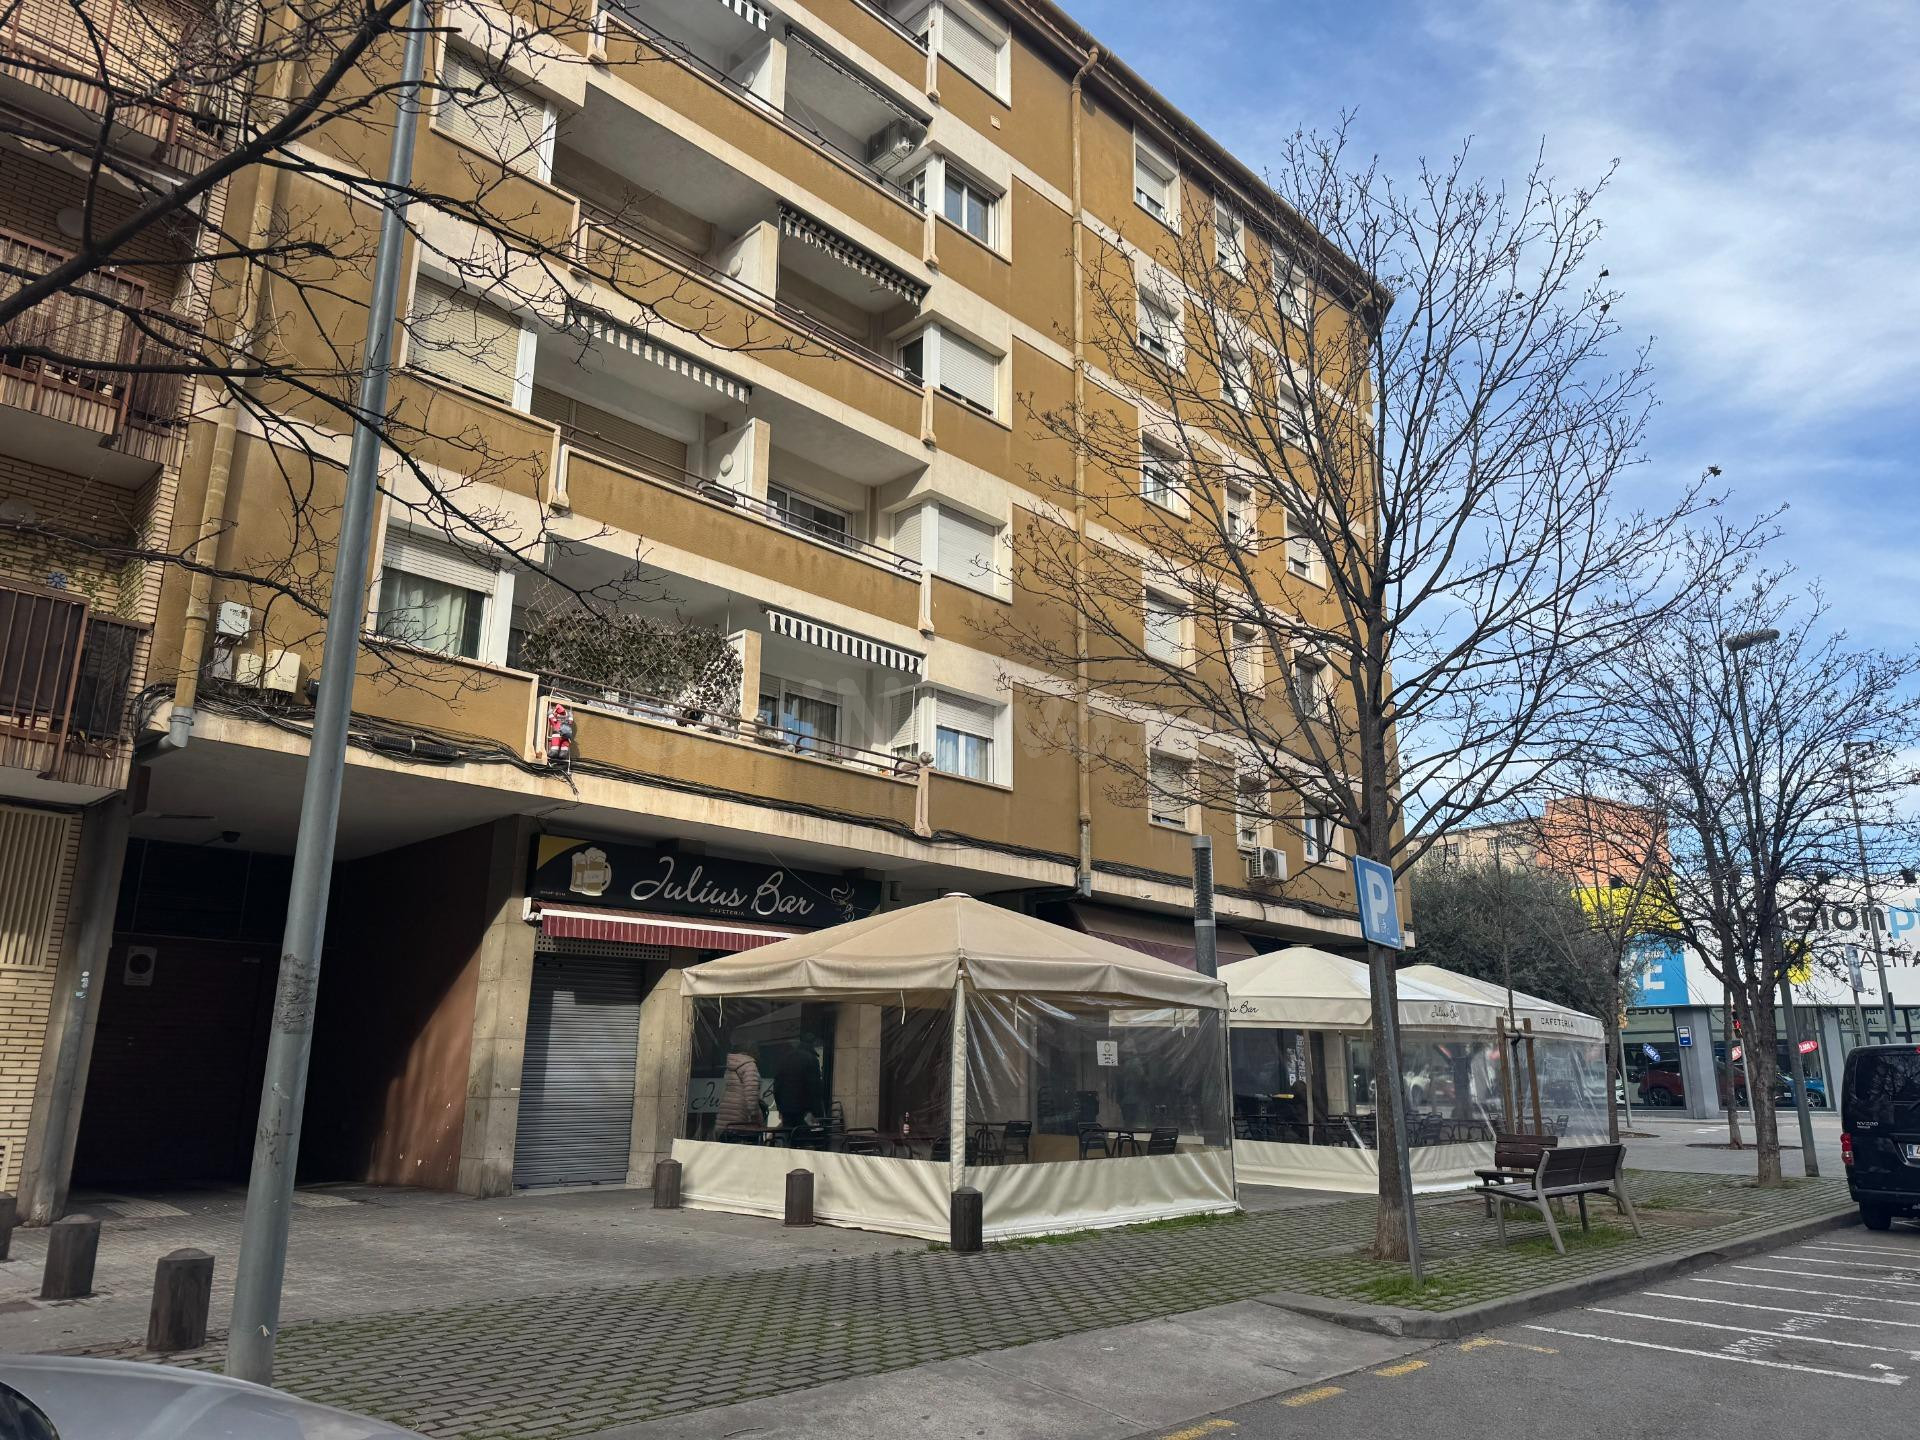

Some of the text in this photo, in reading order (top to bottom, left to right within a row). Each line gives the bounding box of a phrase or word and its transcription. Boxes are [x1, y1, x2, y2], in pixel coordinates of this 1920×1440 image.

[631, 856, 814, 916] Julius Bar
[1365, 869, 1389, 934] P
[1240, 1000, 1259, 1014] Bar
[1540, 1017, 1574, 1029] CAFETERIA
